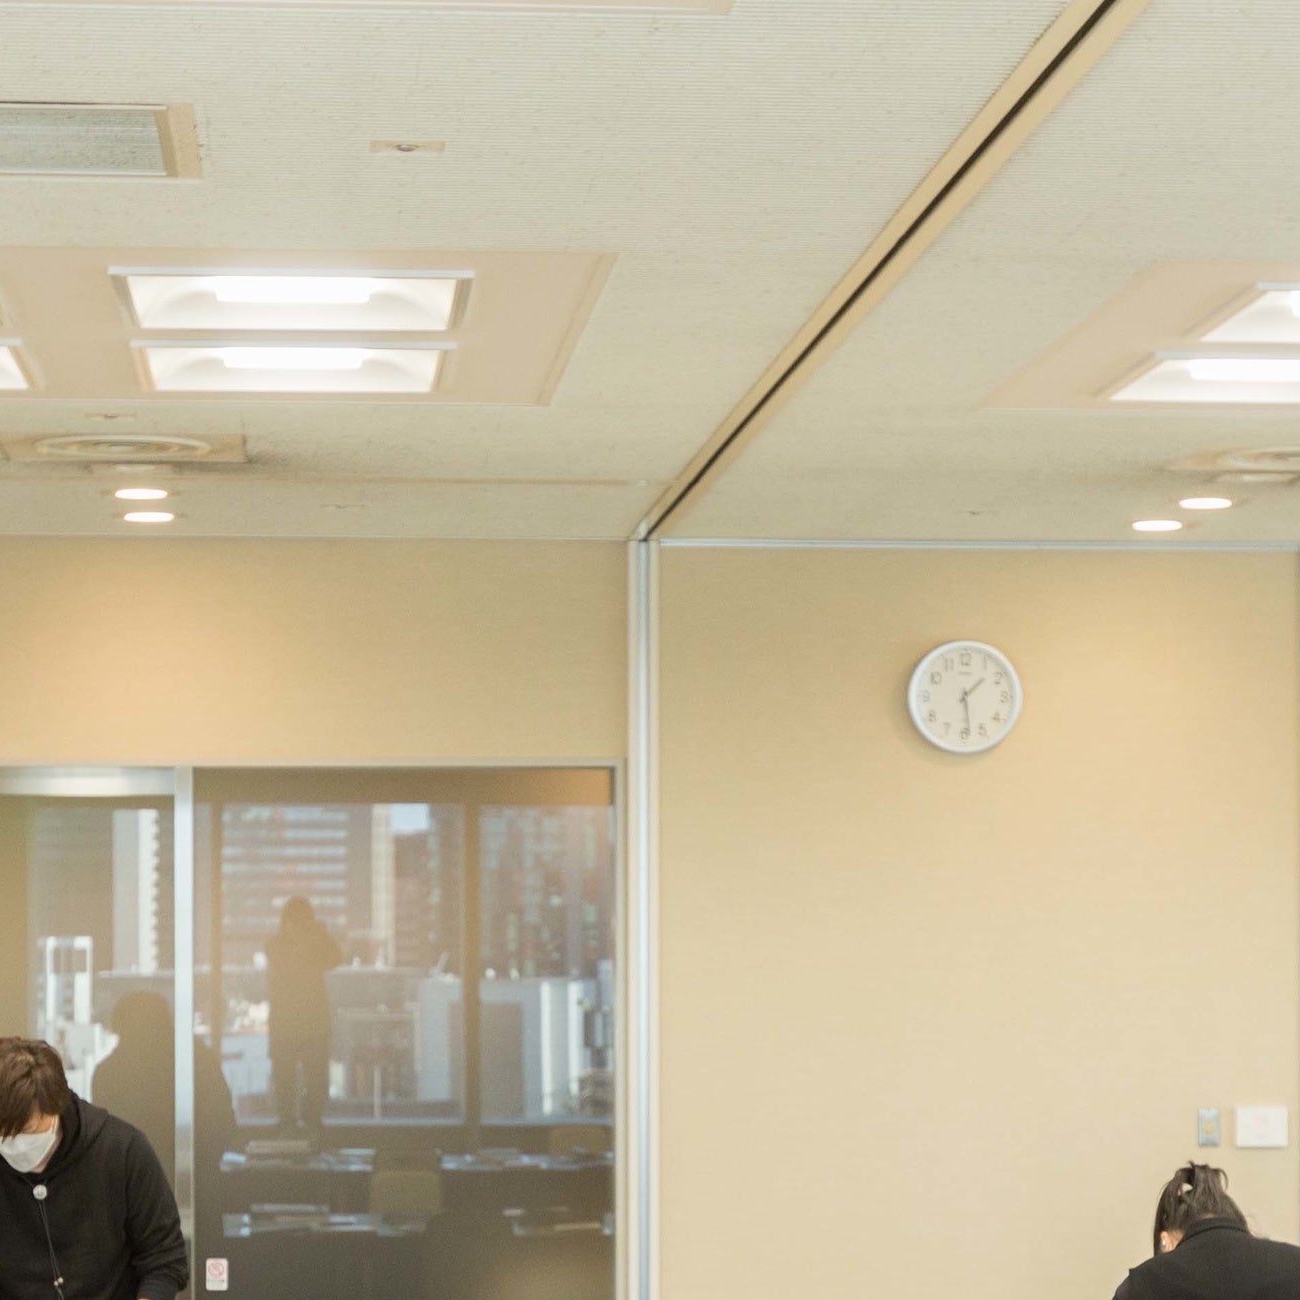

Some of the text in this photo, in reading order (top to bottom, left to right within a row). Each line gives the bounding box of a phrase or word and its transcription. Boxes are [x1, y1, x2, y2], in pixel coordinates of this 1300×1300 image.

[944, 658, 954, 672] 11
[959, 652, 972, 666] 12
[930, 671, 942, 685] 10
[994, 671, 1004, 685] 2
[943, 721, 951, 734] 7
[979, 722, 988, 736] 5
